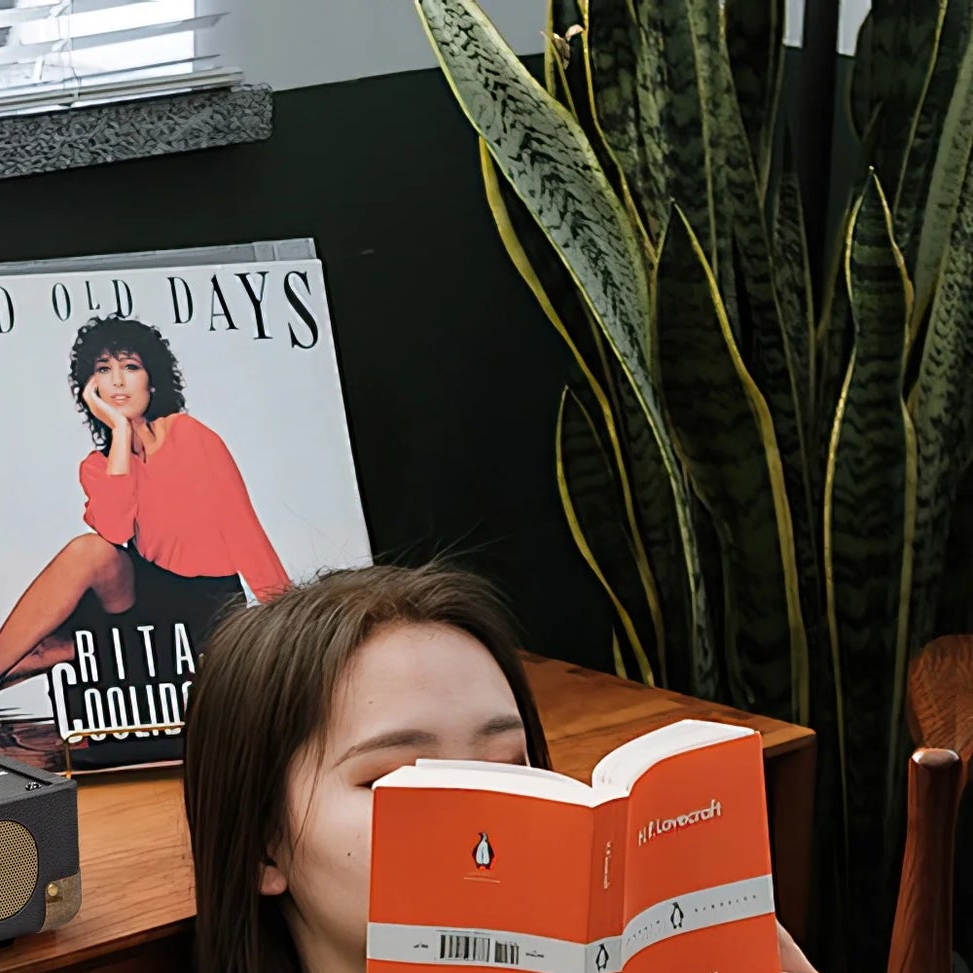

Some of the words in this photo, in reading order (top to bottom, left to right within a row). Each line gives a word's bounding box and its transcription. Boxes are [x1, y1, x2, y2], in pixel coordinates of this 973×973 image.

[52, 279, 134, 322] OLD
[168, 270, 319, 349] DAYS
[75, 623, 196, 683] RITA
